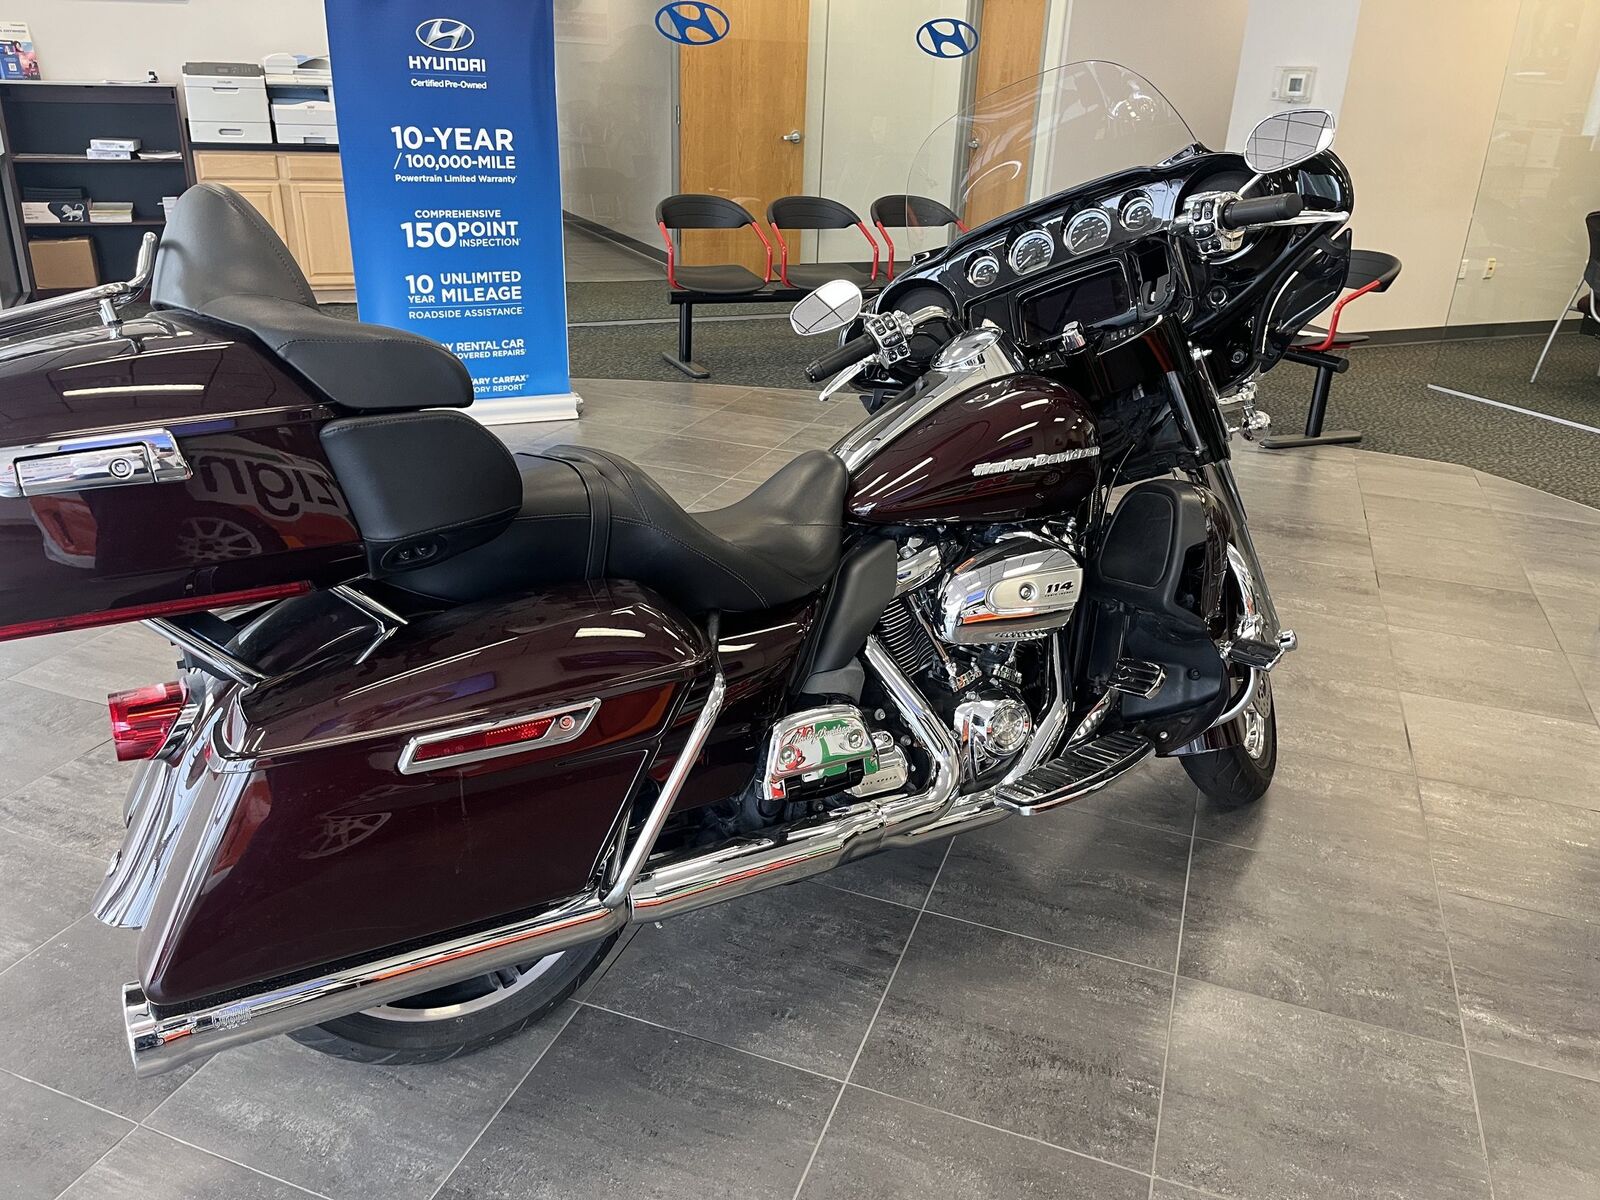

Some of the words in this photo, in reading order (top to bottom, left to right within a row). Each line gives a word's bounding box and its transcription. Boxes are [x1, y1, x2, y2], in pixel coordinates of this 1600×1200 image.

[408, 55, 486, 72] HYUNDAI
[410, 79, 444, 88] Certified
[444, 80, 488, 90] Pre-Owned
[390, 125, 515, 152] 10-YEAR
[394, 174, 443, 183] Powertrain
[444, 175, 477, 183] Limited
[414, 209, 502, 219] COMPREHENSIVE
[400, 221, 457, 248] 150
[458, 220, 519, 237] POINT
[459, 238, 521, 248] INSPECTION
[405, 274, 434, 295] 10
[440, 270, 522, 285] UNLIMITED
[407, 295, 436, 304] YEAR
[441, 286, 522, 303] MILEAGE
[408, 310, 462, 320] ROADSIDE
[464, 307, 524, 317] ASSISTANCE
[456, 340, 500, 352] RENTAL
[501, 338, 525, 349] CAR
[492, 348, 527, 358] REPAIRS
[471, 377, 491, 385] ARY
[1046, 581, 1074, 594] 114
